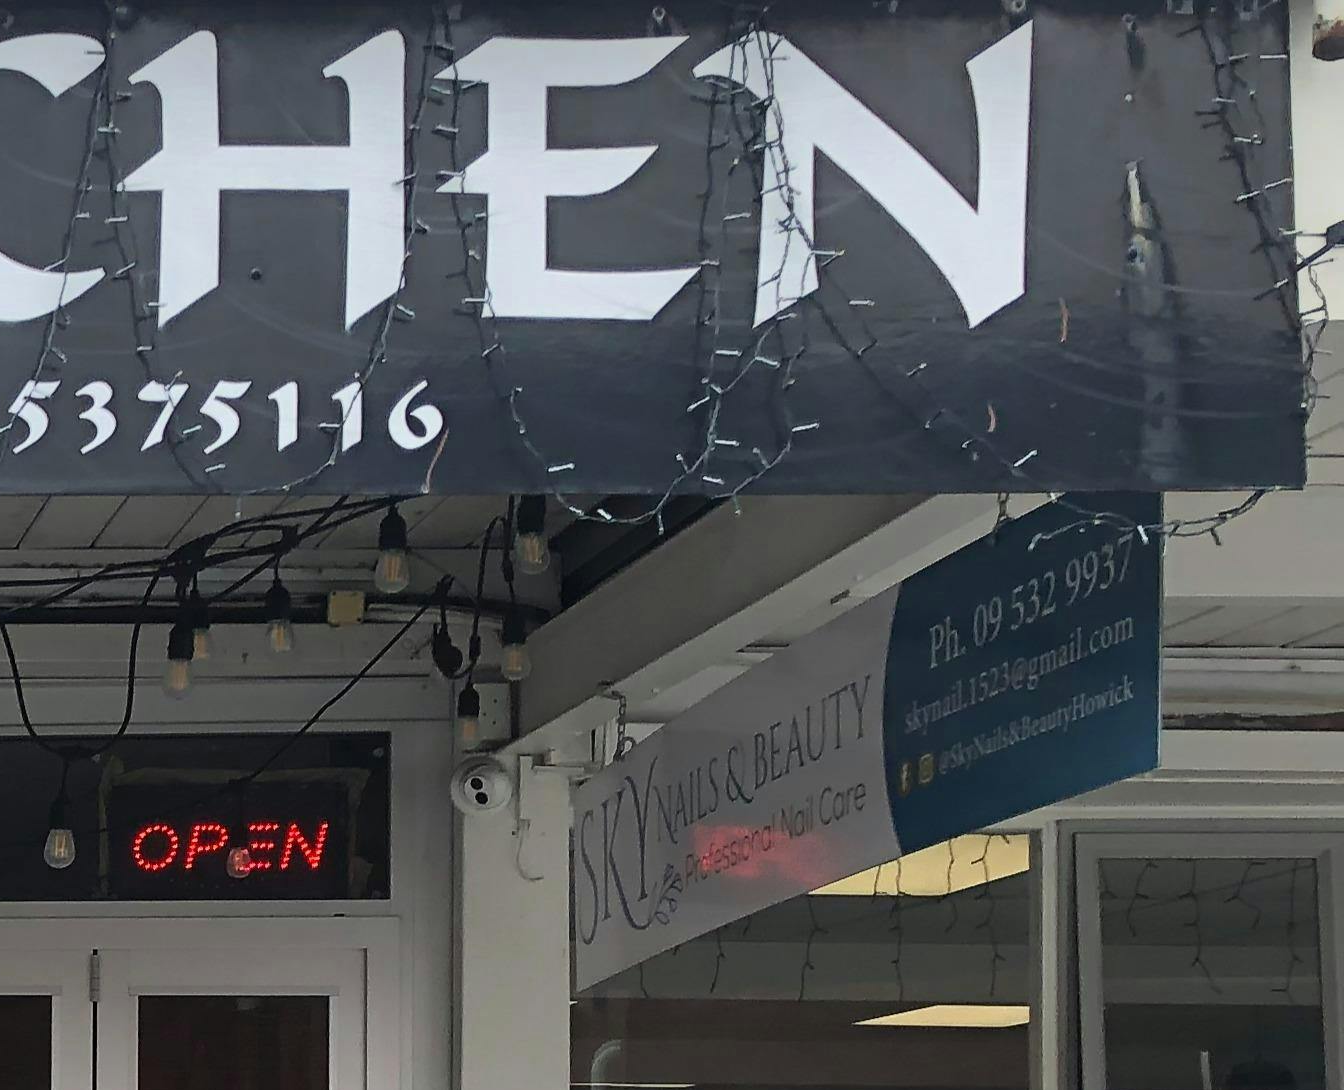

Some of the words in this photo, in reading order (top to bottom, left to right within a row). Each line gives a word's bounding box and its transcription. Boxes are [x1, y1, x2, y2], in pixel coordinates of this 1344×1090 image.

[8, 379, 445, 455] 5375116
[928, 617, 968, 670] Ph.
[972, 604, 1003, 648] 09
[1011, 573, 1057, 631] 532
[1065, 534, 1135, 607] 9937
[904, 613, 1135, 735] skynail.1523@gmail.com
[132, 822, 330, 872] OPEN
[578, 756, 659, 945] SKY
[653, 756, 720, 844] NAILS
[726, 744, 754, 806] &
[753, 674, 871, 791] BEAUTY
[684, 813, 778, 887] Professional
[779, 799, 815, 842] Nail
[819, 779, 867, 827] Care
